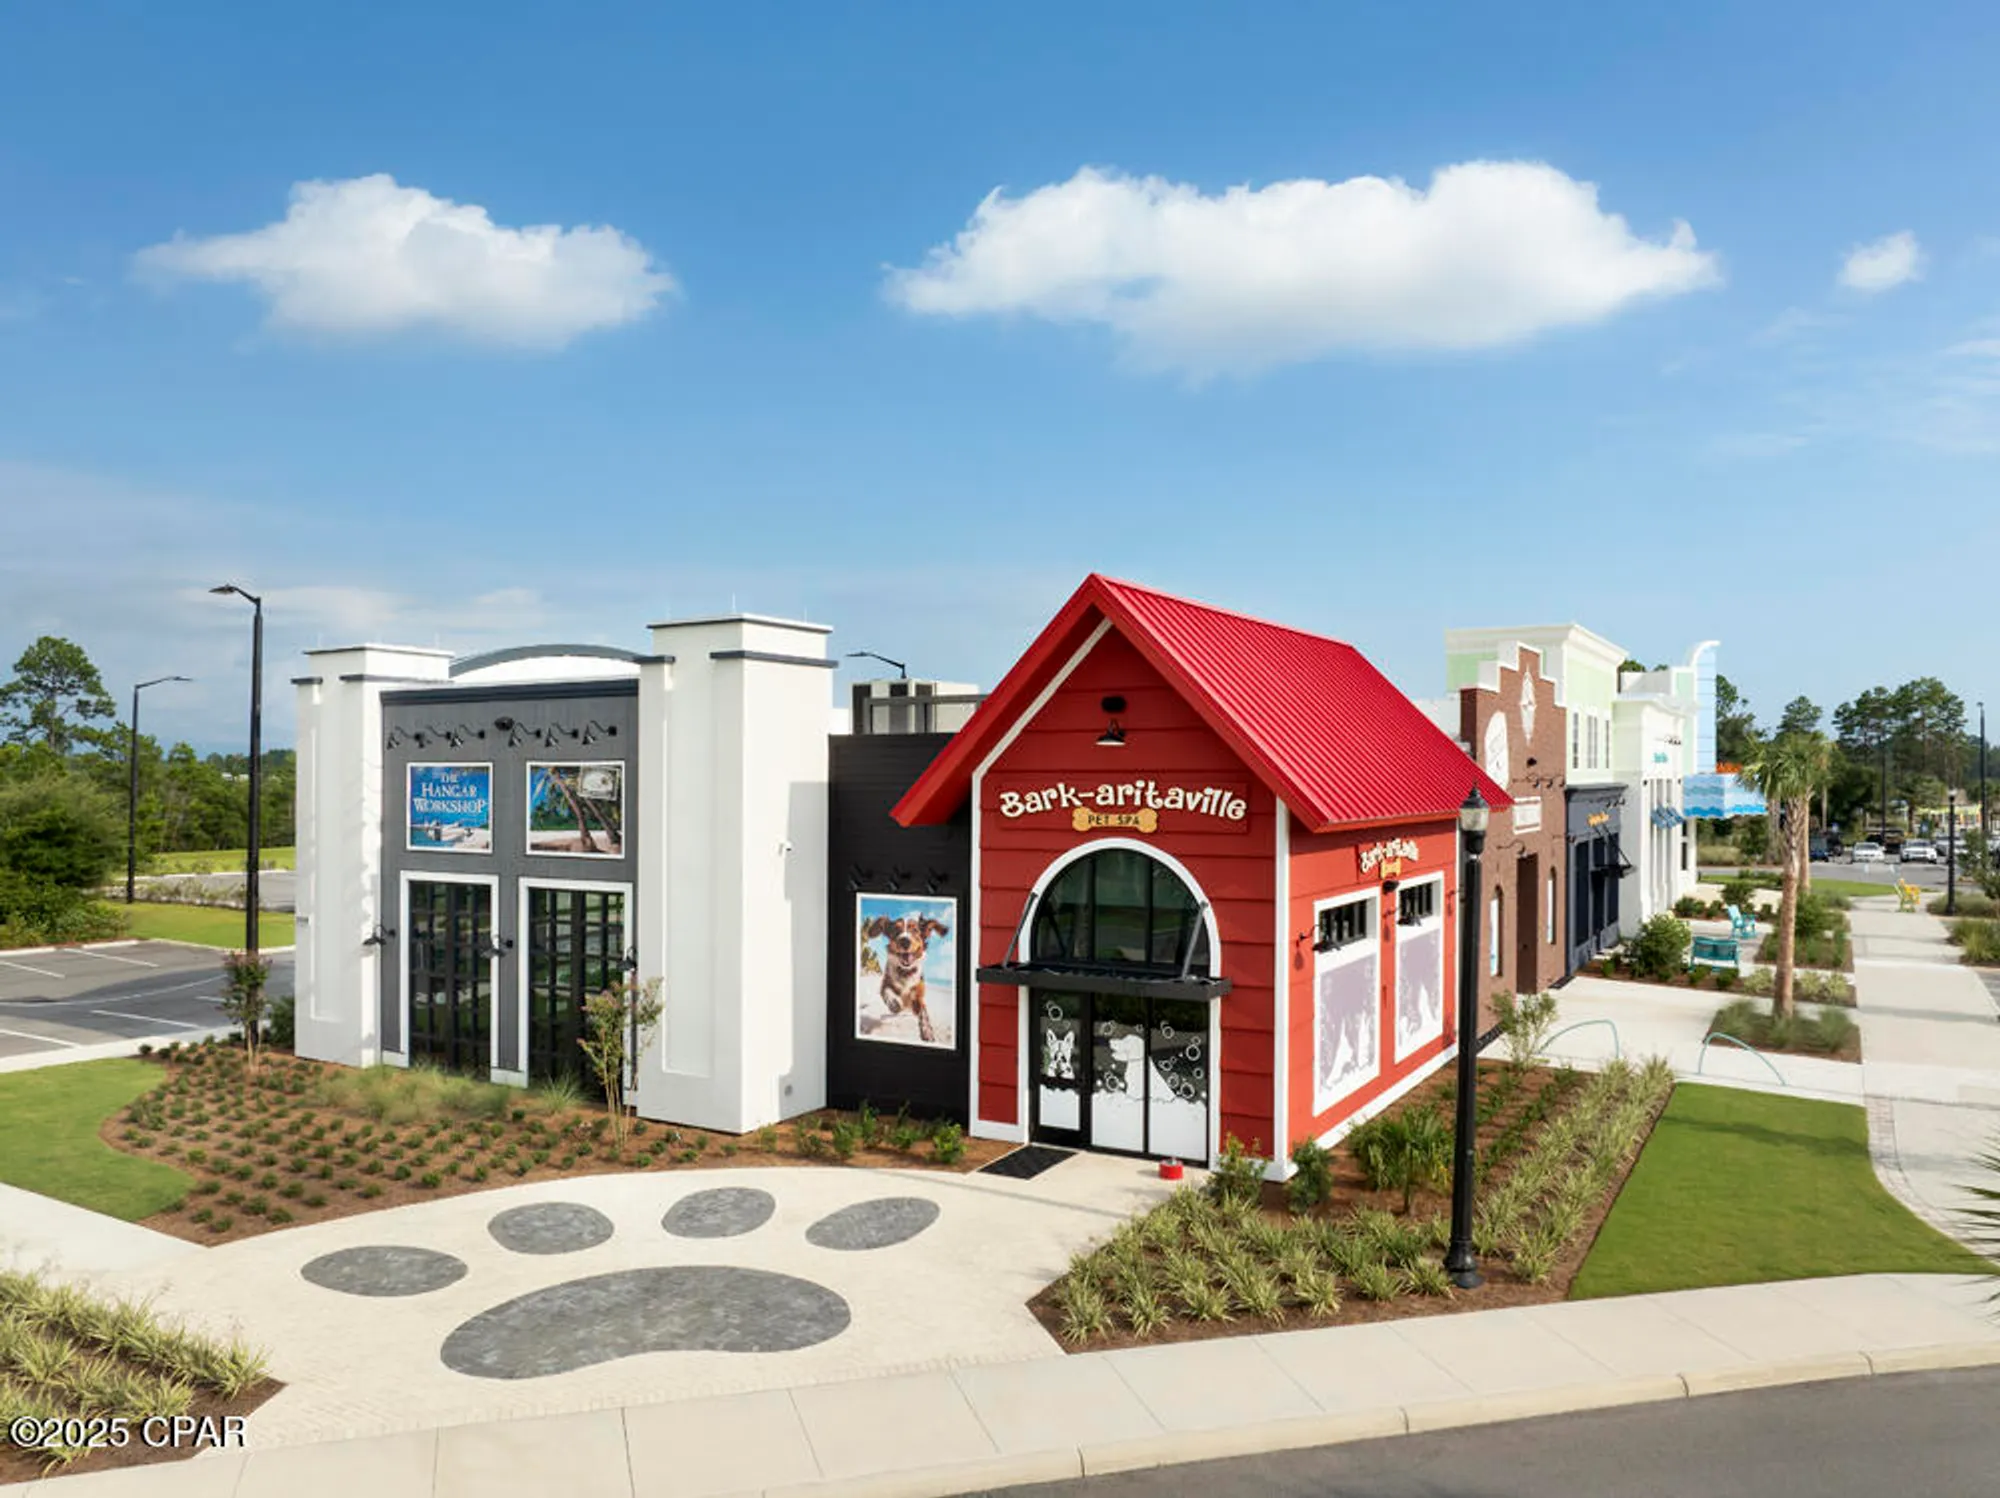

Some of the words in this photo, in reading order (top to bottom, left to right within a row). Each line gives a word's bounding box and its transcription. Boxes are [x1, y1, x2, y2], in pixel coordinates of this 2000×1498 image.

[413, 798, 486, 813] WORKSHOP
[1000, 780, 1247, 820] Bark-aritaville
[1088, 814, 1109, 825] PET
[1118, 815, 1140, 825] SPA
